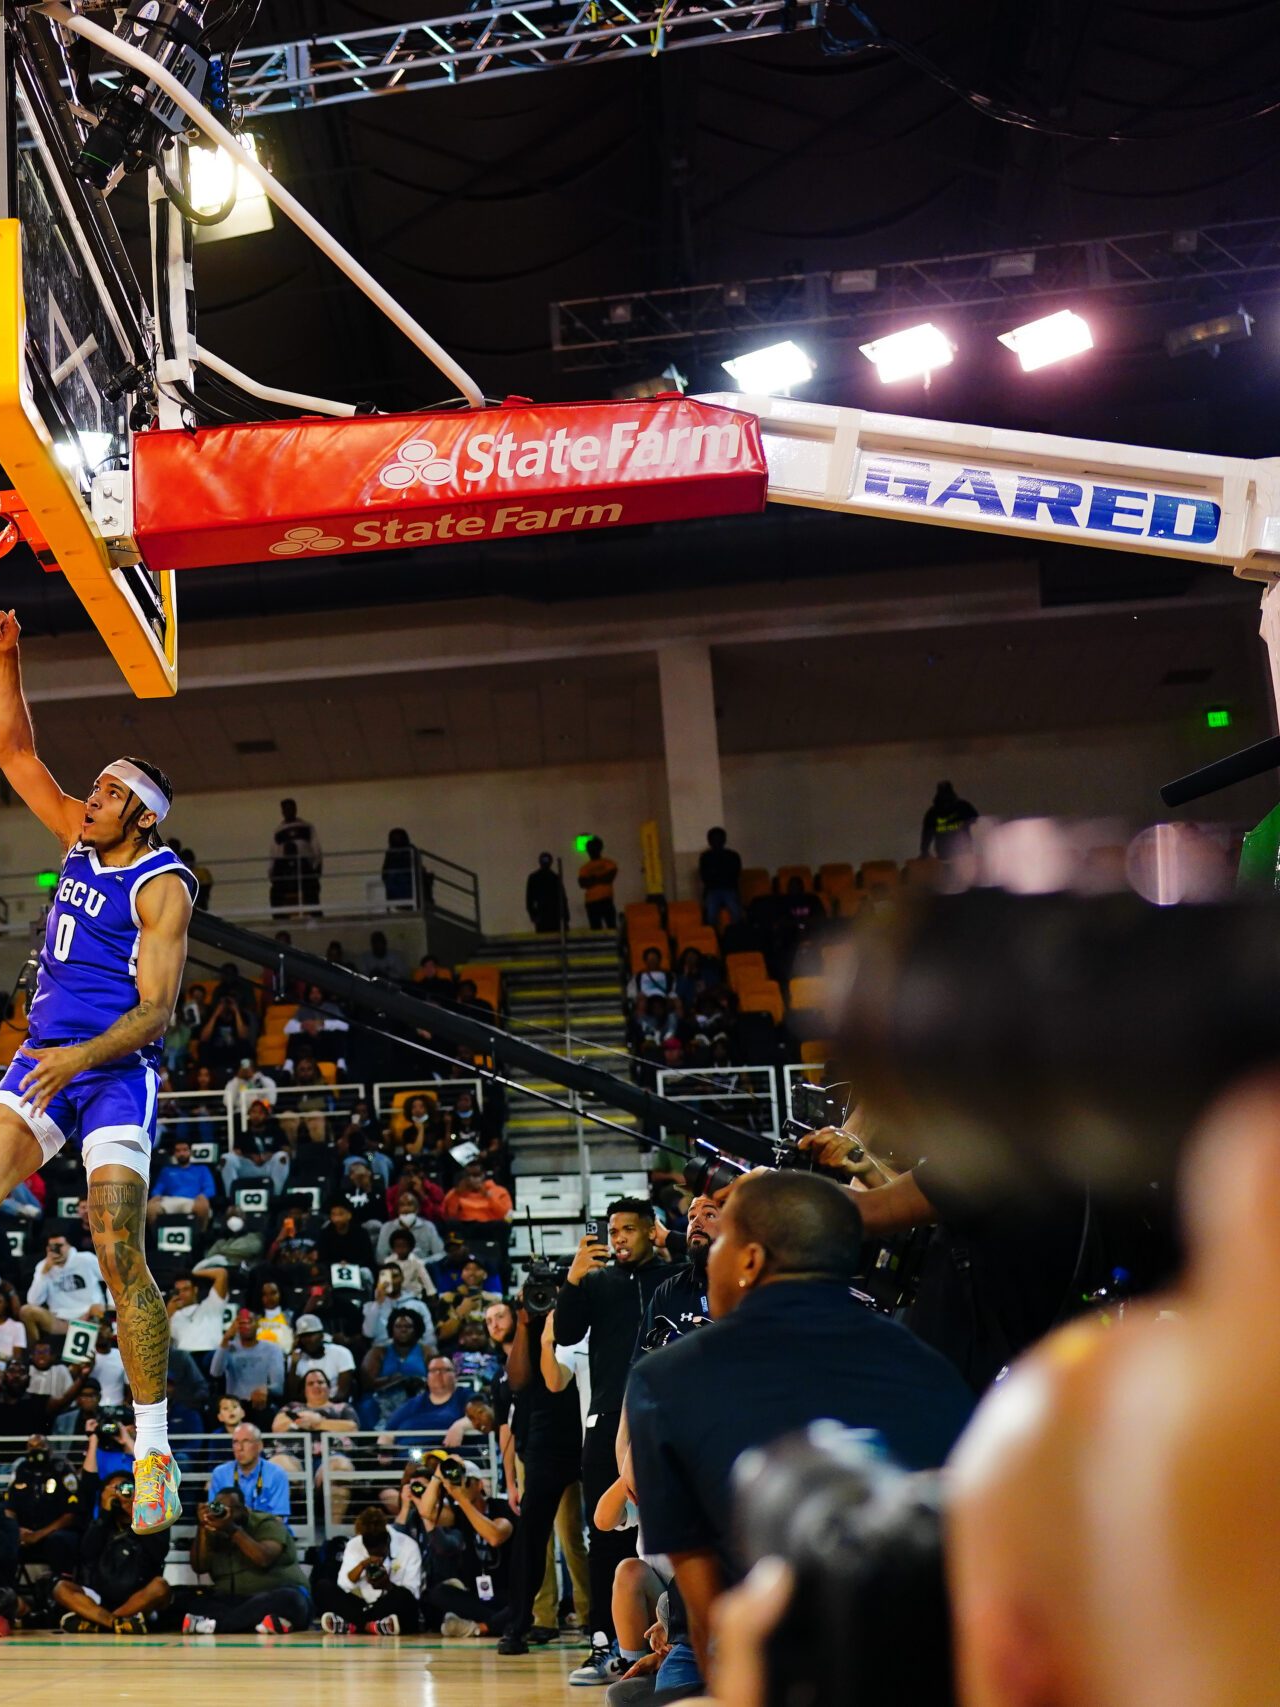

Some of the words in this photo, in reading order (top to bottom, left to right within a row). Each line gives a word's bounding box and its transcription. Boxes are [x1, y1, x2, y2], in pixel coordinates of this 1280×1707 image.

[865, 457, 1221, 544] GARED
[59, 876, 107, 918] GCU
[53, 913, 77, 962] 0
[243, 1193, 262, 1205] 8
[166, 1232, 186, 1245] 8
[337, 1267, 353, 1281] 8
[71, 1331, 90, 1357] 9
